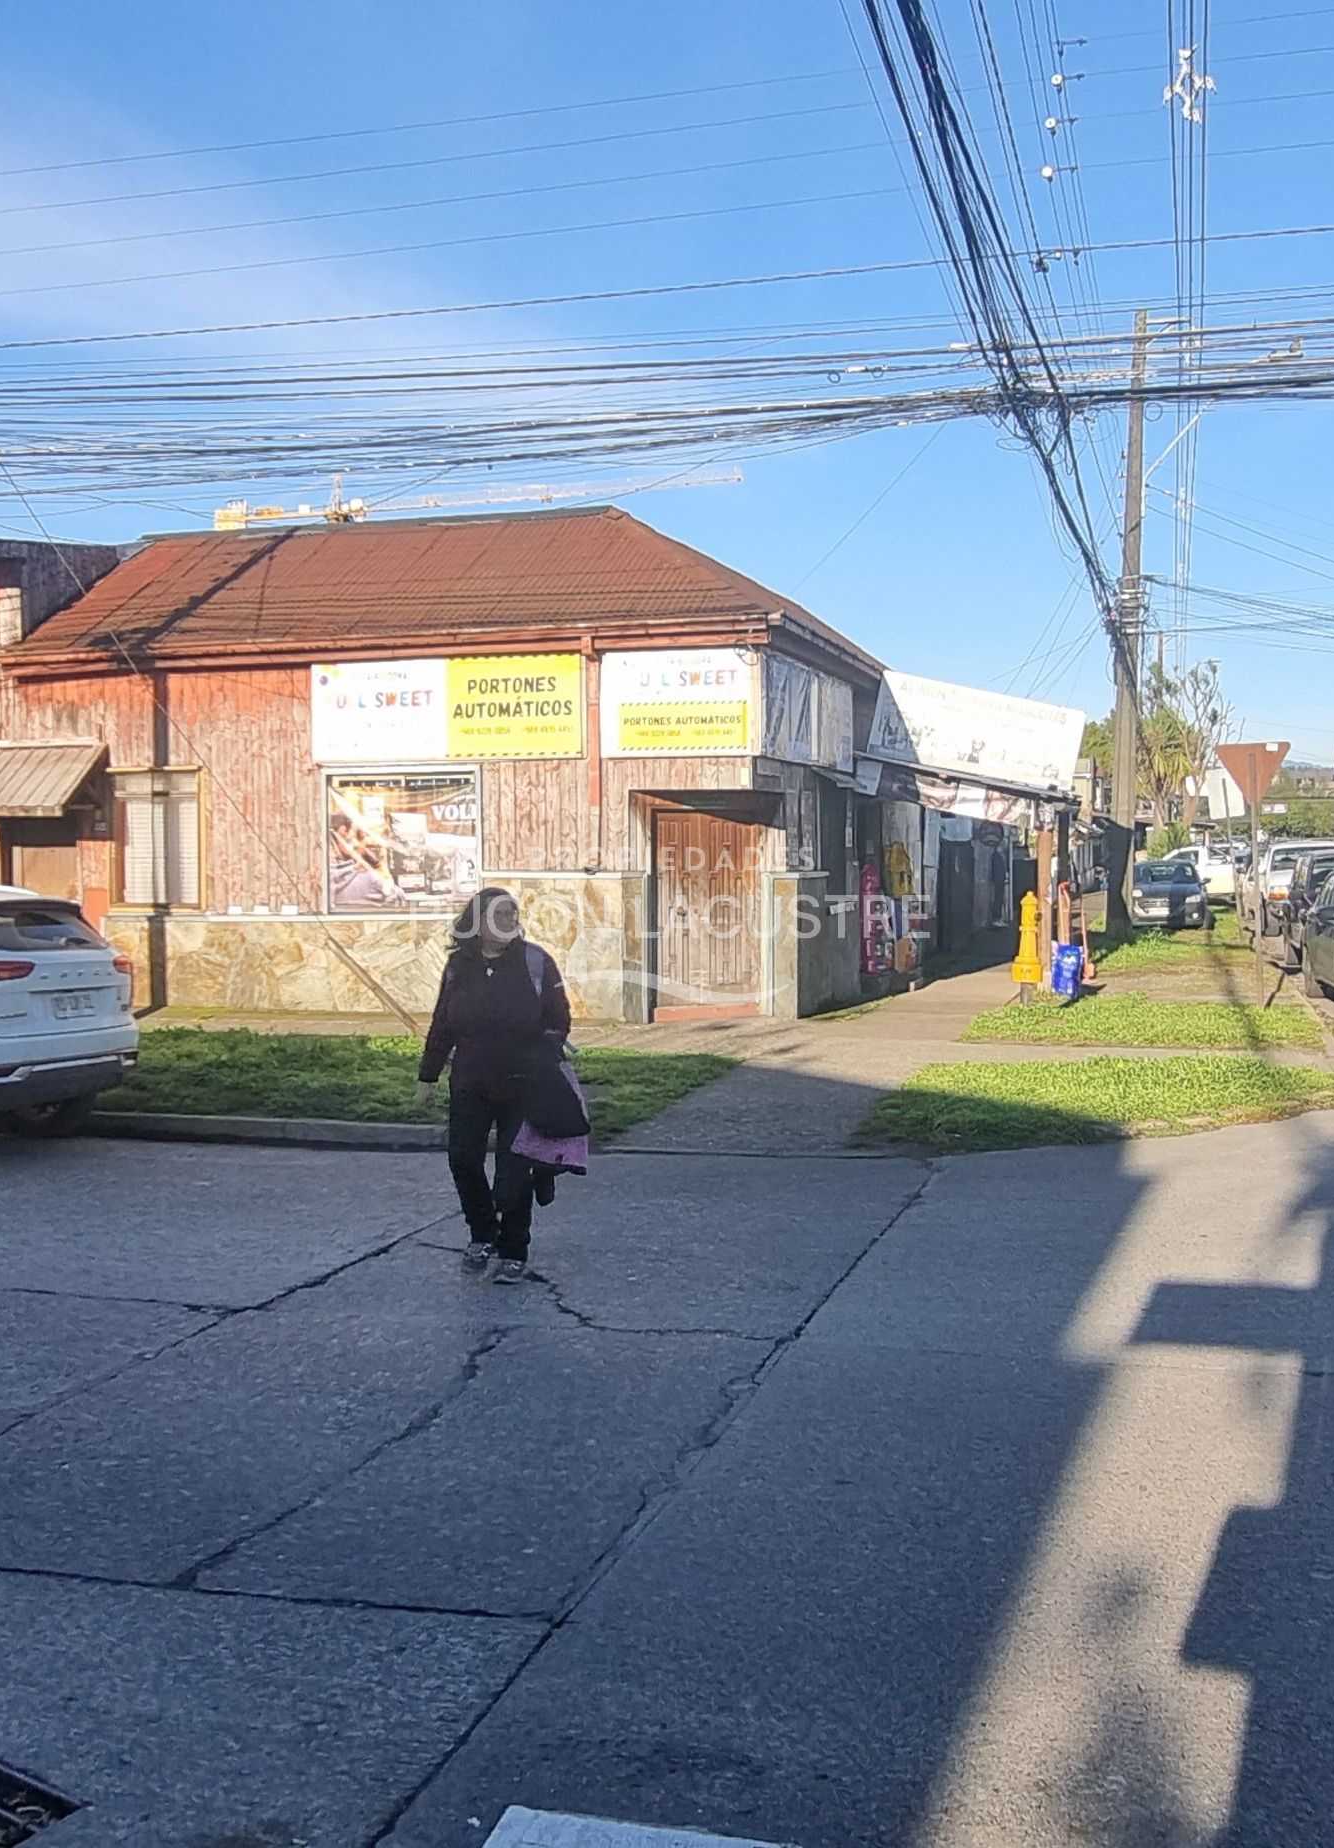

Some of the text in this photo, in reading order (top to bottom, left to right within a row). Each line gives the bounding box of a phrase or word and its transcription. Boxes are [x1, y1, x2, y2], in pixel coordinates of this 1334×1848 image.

[467, 676, 557, 695] PORTONES
[678, 669, 737, 687] SWEET
[374, 689, 433, 708] SWEET
[452, 696, 573, 719] AUTOMÁTICOS
[623, 716, 672, 727] PORTONES
